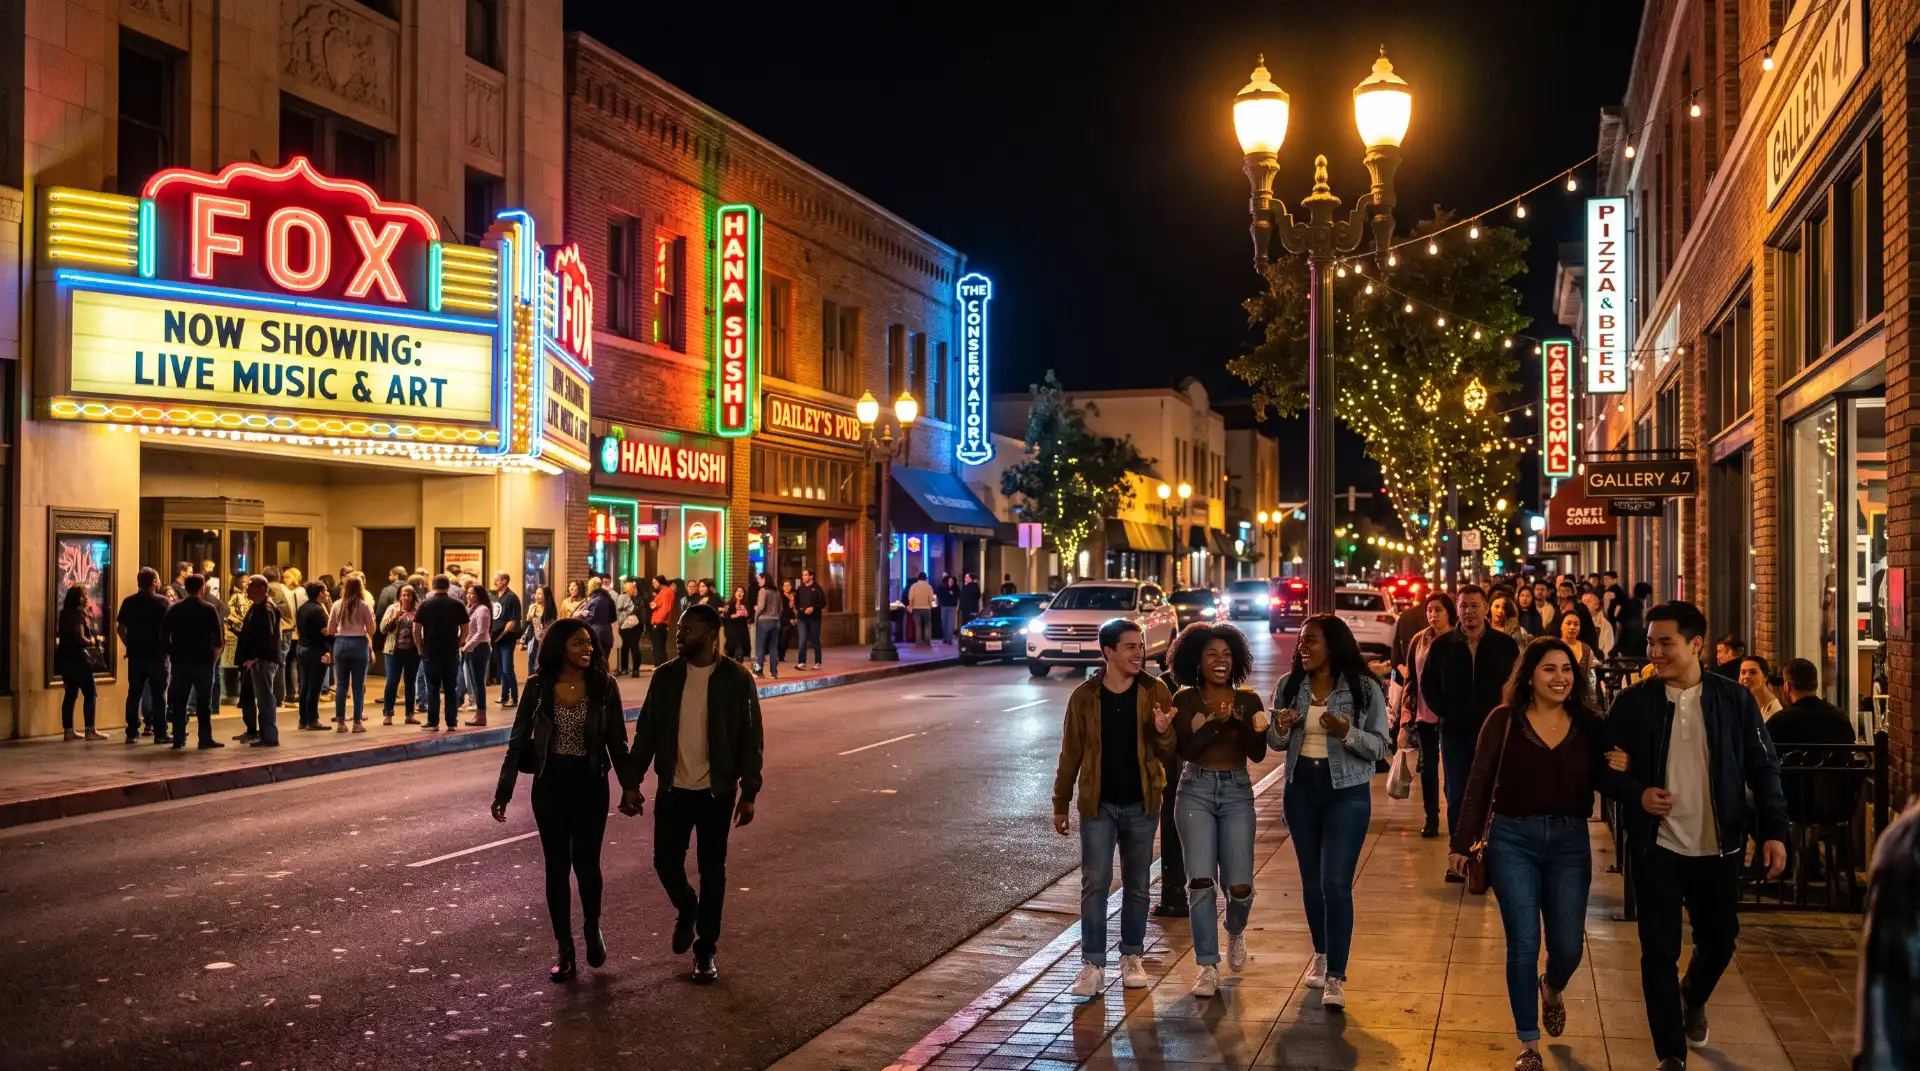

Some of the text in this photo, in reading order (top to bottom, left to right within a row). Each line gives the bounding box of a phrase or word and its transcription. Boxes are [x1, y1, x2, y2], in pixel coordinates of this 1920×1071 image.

[1773, 5, 1850, 185] GALLERY 47
[190, 192, 408, 302] FOX
[562, 271, 593, 367] FOX
[723, 215, 744, 426] HANA SUSHI
[961, 285, 987, 296] THE
[1597, 206, 1616, 384] PIZZA & BEER
[164, 309, 423, 366] NOW SHOWING:
[967, 300, 981, 451] CONSERVATORY
[134, 351, 448, 408] LIVE MUSIC & ART
[1549, 346, 1567, 470] CAFE COMAL
[772, 400, 861, 441] DAILEY'S PUB
[621, 440, 726, 484] HANA SUSHI
[1589, 471, 1691, 487] GALLERY 47
[1566, 517, 1606, 526] COMAL
